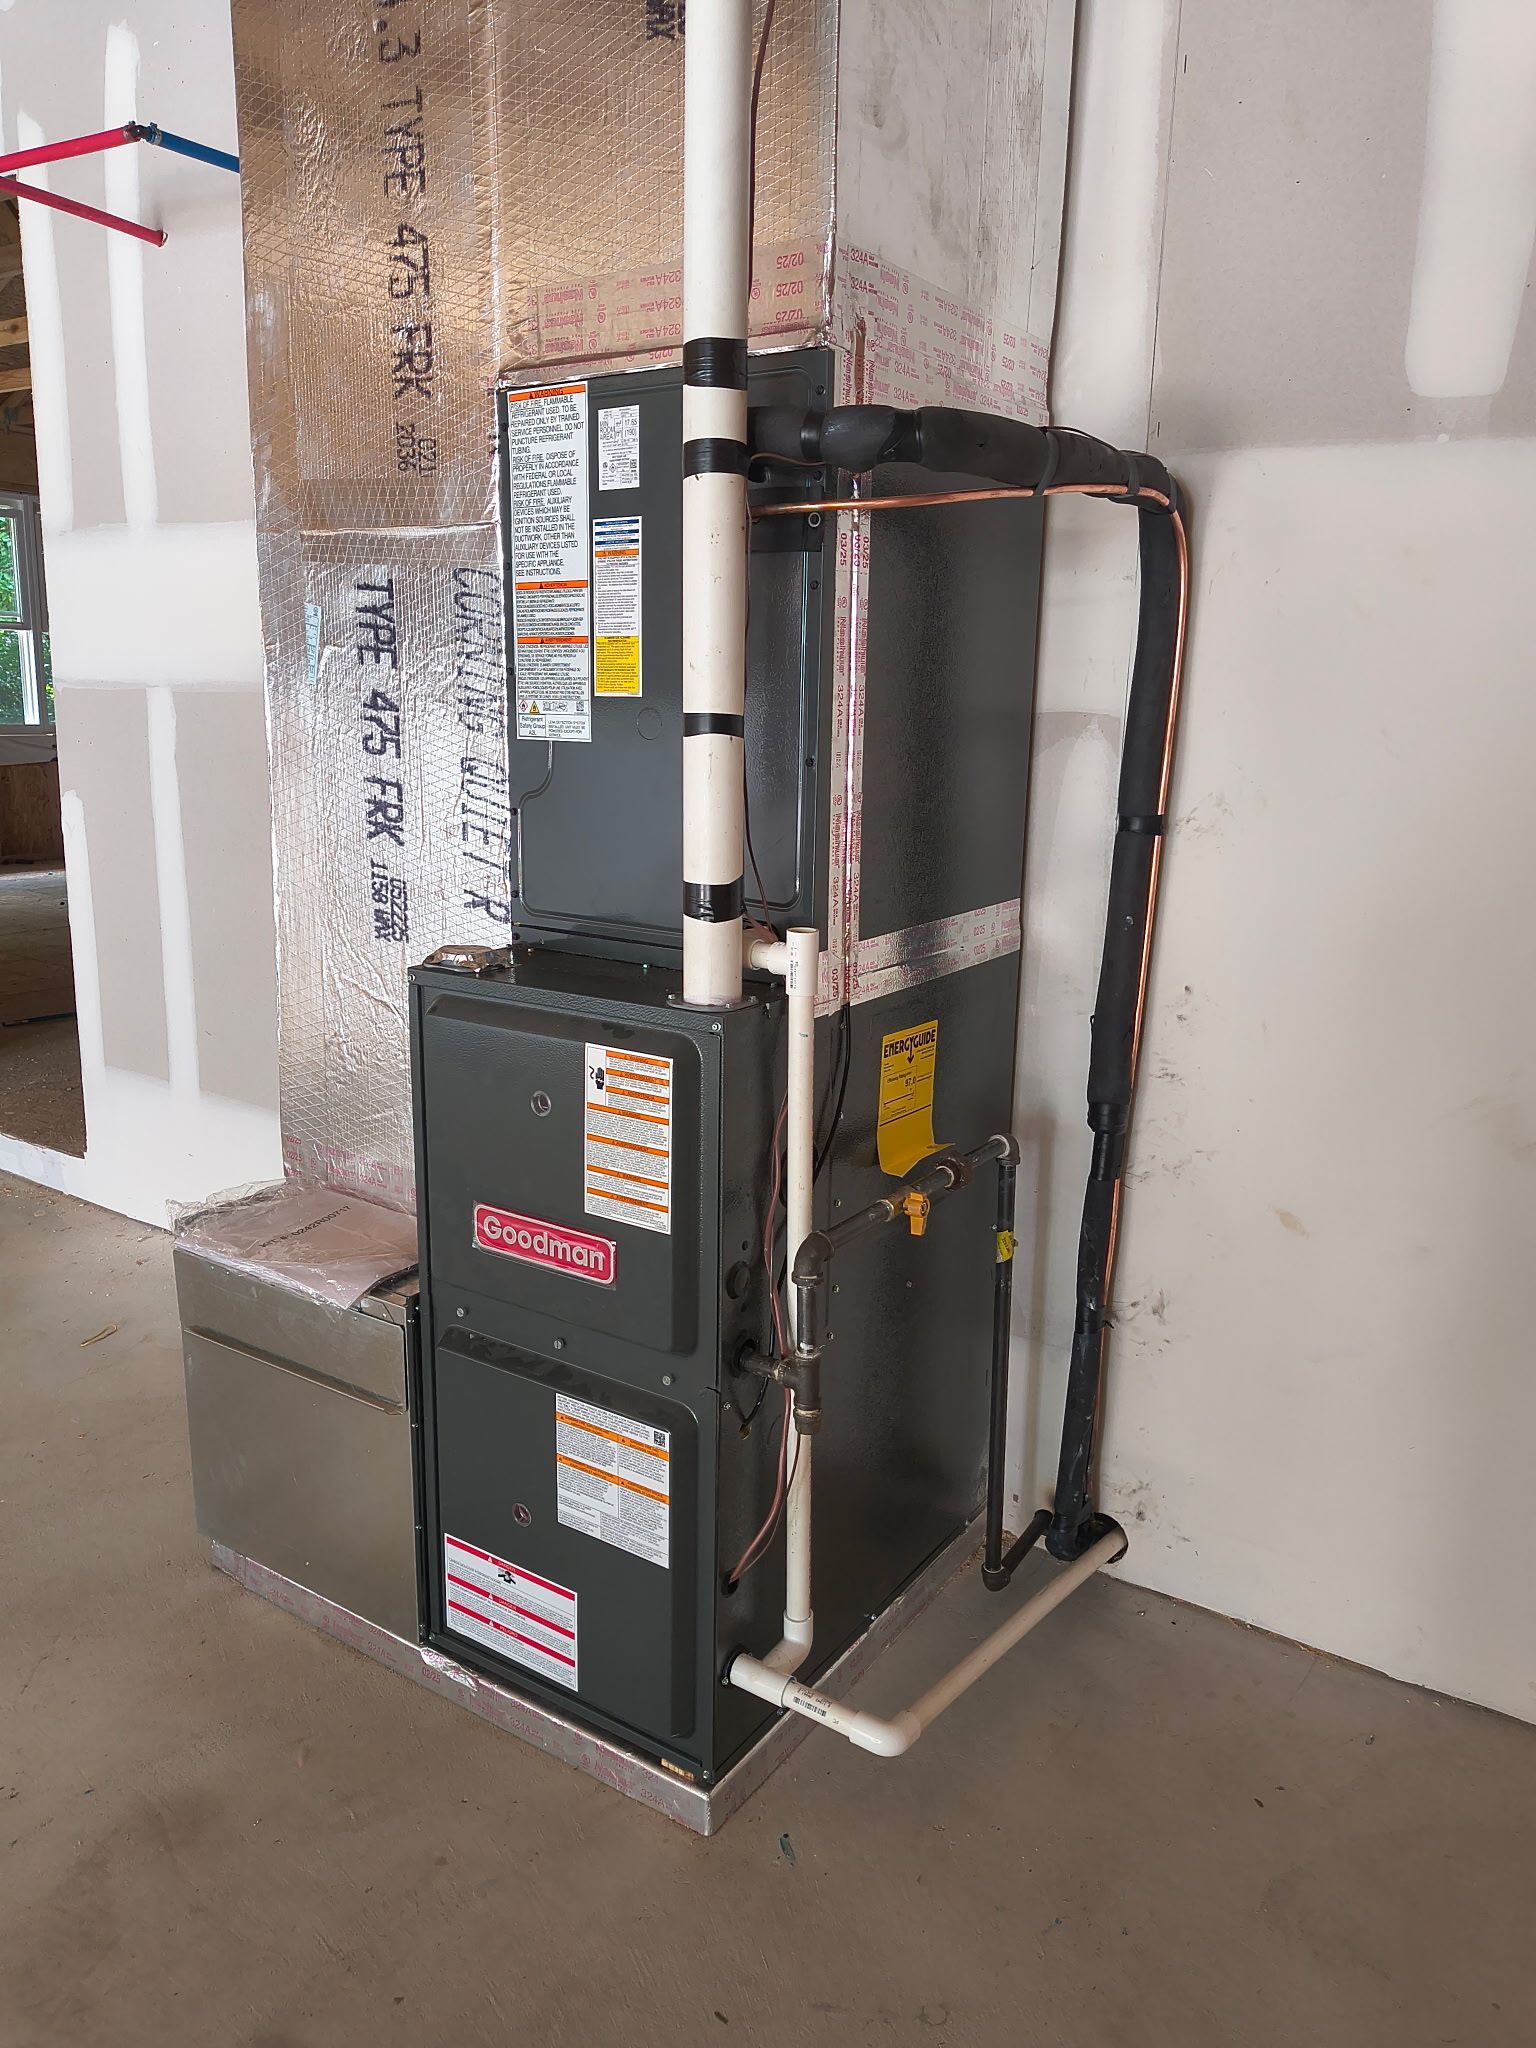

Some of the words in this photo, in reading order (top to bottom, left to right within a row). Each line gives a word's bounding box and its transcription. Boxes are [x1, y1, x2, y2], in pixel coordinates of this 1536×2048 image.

[381, 86, 426, 198] TYPE
[387, 222, 430, 299] 475
[776, 252, 804, 269] 02/25
[850, 248, 869, 266] 324A
[655, 270, 681, 282] 324A
[776, 280, 804, 297] 02/25
[850, 276, 869, 293] 324A
[655, 297, 681, 308] 324A
[655, 323, 681, 334] 324A
[391, 321, 433, 401] FRK
[840, 532, 848, 566] 03/25
[862, 536, 870, 569] 03/25
[356, 579, 398, 669] TYPE
[361, 688, 401, 759] 475
[363, 776, 405, 846] FRK
[831, 968, 839, 998] 03/25
[884, 1029, 937, 1059] ENERGYGUIDE
[483, 1215, 606, 1272] Goodman
